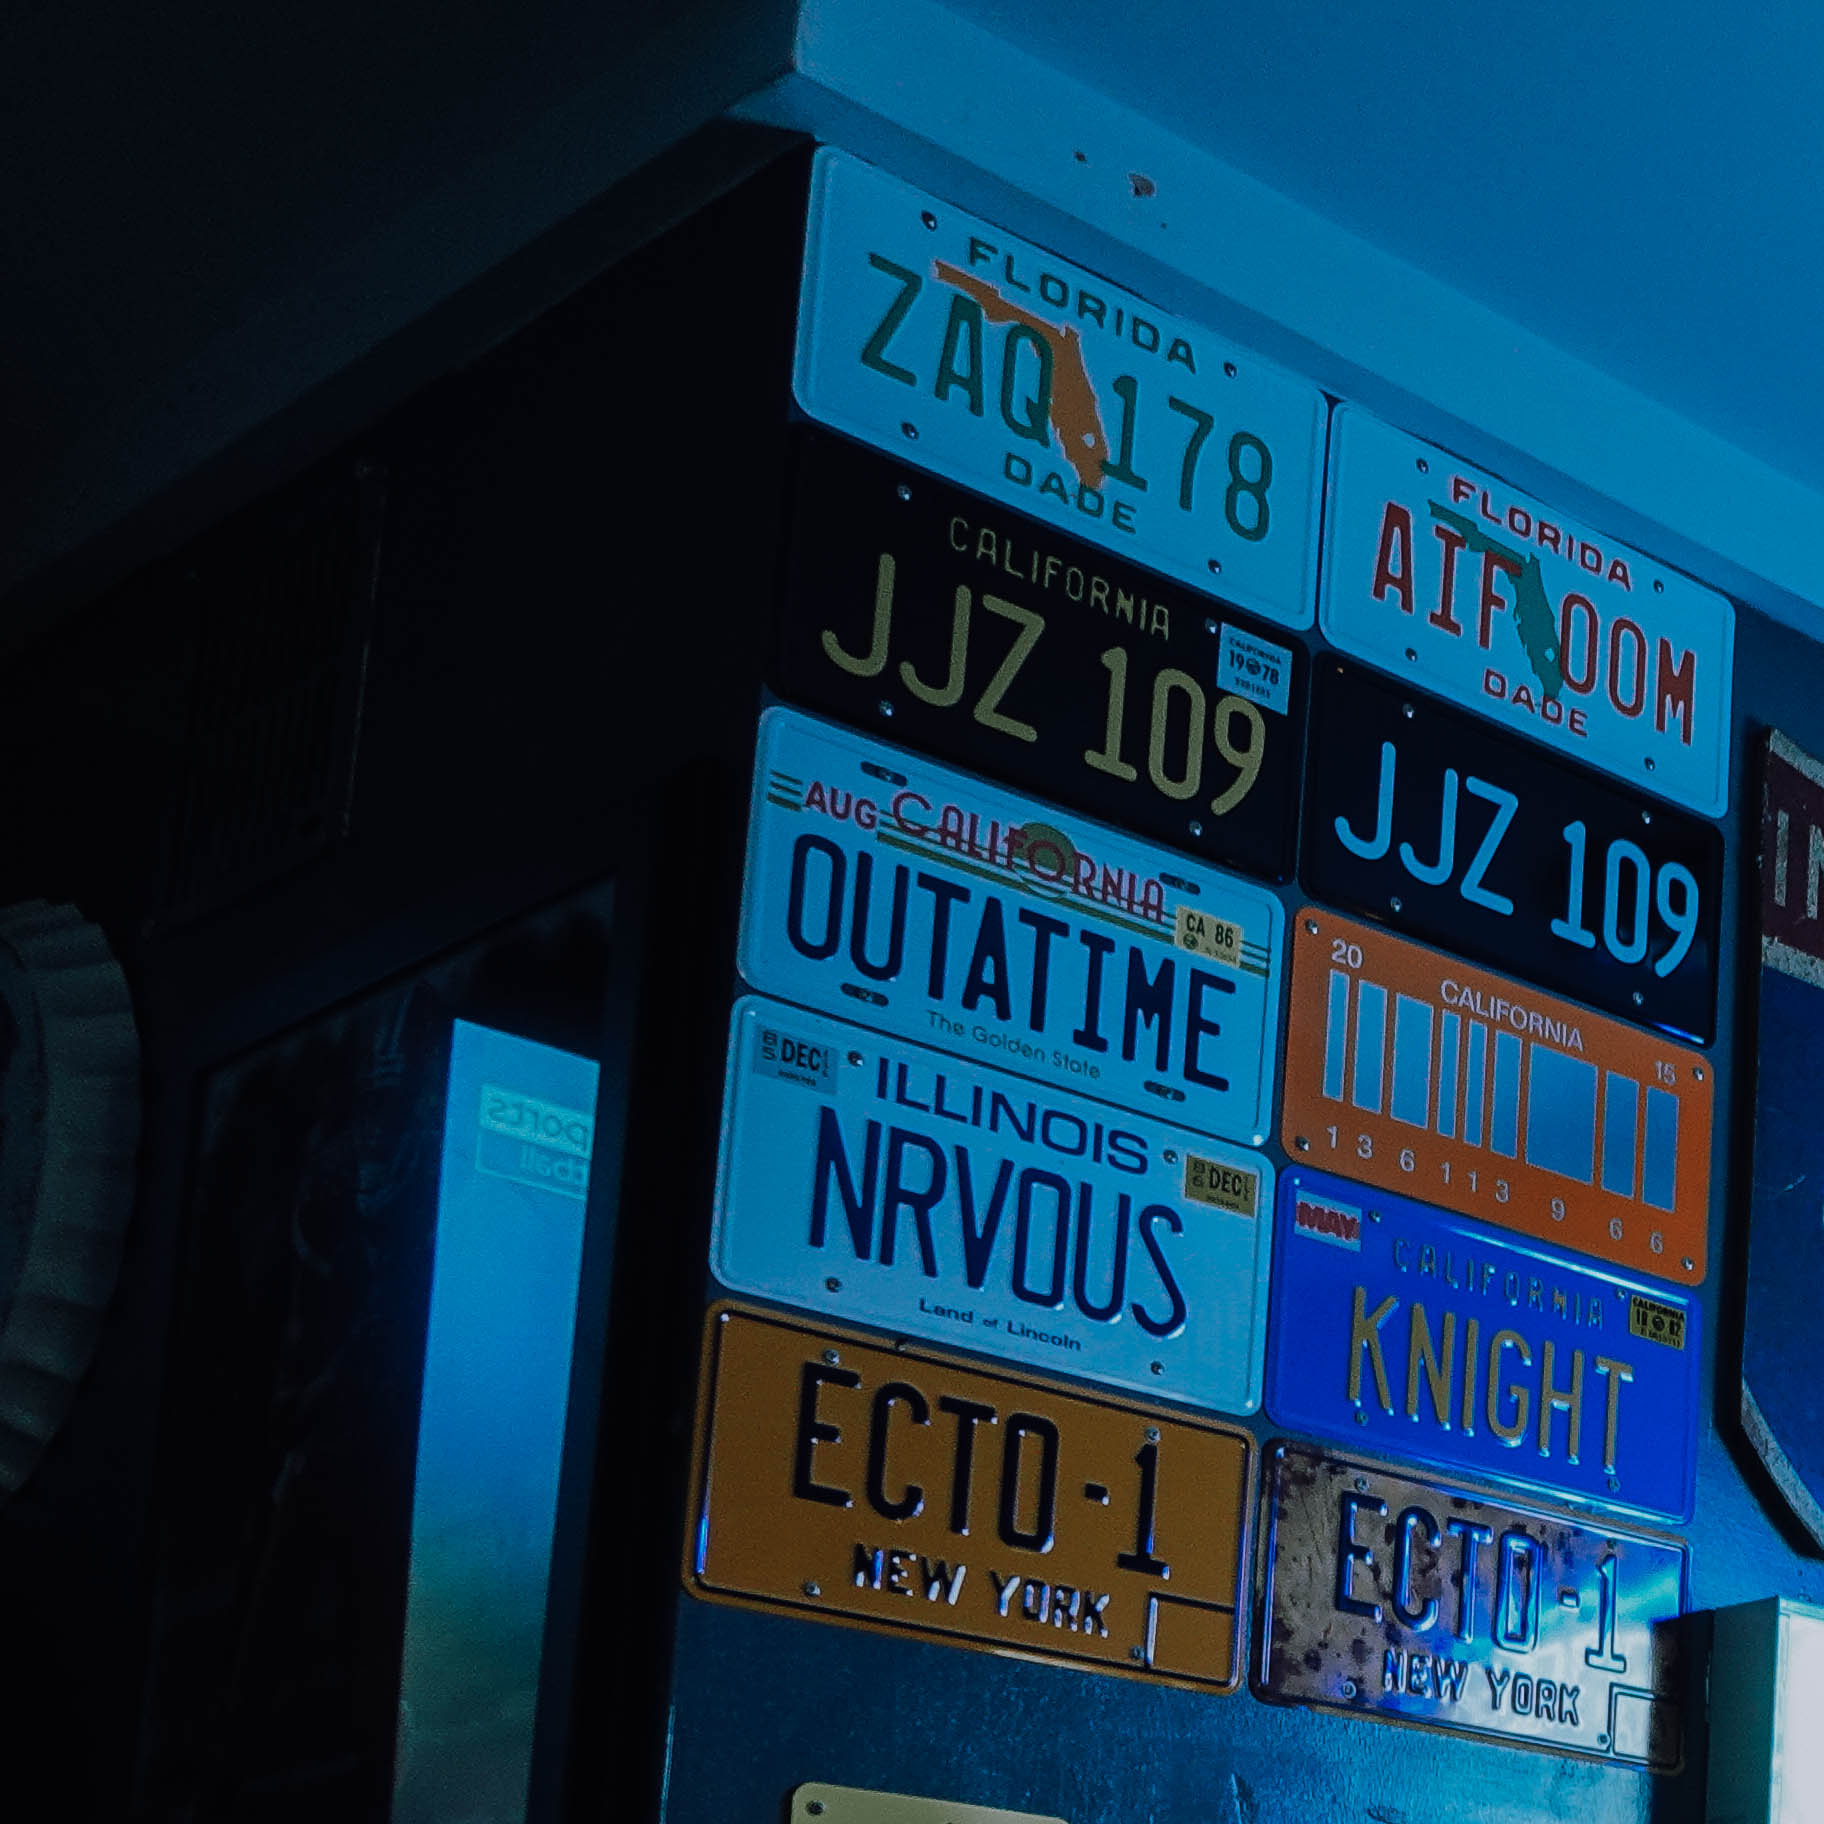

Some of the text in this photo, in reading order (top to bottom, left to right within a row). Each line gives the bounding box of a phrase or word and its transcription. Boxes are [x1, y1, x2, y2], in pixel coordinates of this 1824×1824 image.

[967, 236, 1197, 375] FLORIDA
[859, 252, 1274, 542] ZAQ 178
[1004, 451, 1137, 534] DADE
[1451, 476, 1632, 591] FLORIDA
[949, 516, 1171, 641] CALIFORNIA
[821, 553, 1266, 814] JJZ 109
[1483, 669, 1588, 737] DADE
[1559, 593, 1697, 745] OOM
[803, 781, 1167, 925] AUG CALIFORNIA
[1334, 741, 1699, 977] JJZ 109
[787, 833, 1236, 1093] OUTATIME
[1186, 913, 1206, 938] CA
[1331, 938, 1364, 969] 20
[780, 1037, 821, 1072] DEC
[926, 1009, 1100, 1081] The Golden State
[1440, 978, 1585, 1052] CALIFORNIA
[1655, 1060, 1676, 1085] 15
[877, 1056, 1149, 1176] ILLINOIS
[809, 1105, 1187, 1340] NRVOUS
[1209, 1165, 1242, 1197] DEC
[1326, 1125, 1665, 1254] 1 3 6 1 1 3 9 6 6
[919, 1298, 1081, 1352] Land of Lincoln
[1394, 1238, 1604, 1329] CALIFORNIA
[1348, 1286, 1634, 1475] KNIGHT
[794, 1361, 1171, 1581] ECTO-1
[854, 1543, 1110, 1638] NEW YORK
[1335, 1490, 1627, 1674] ECTO-1
[1383, 1648, 1580, 1727] NEW YORK
